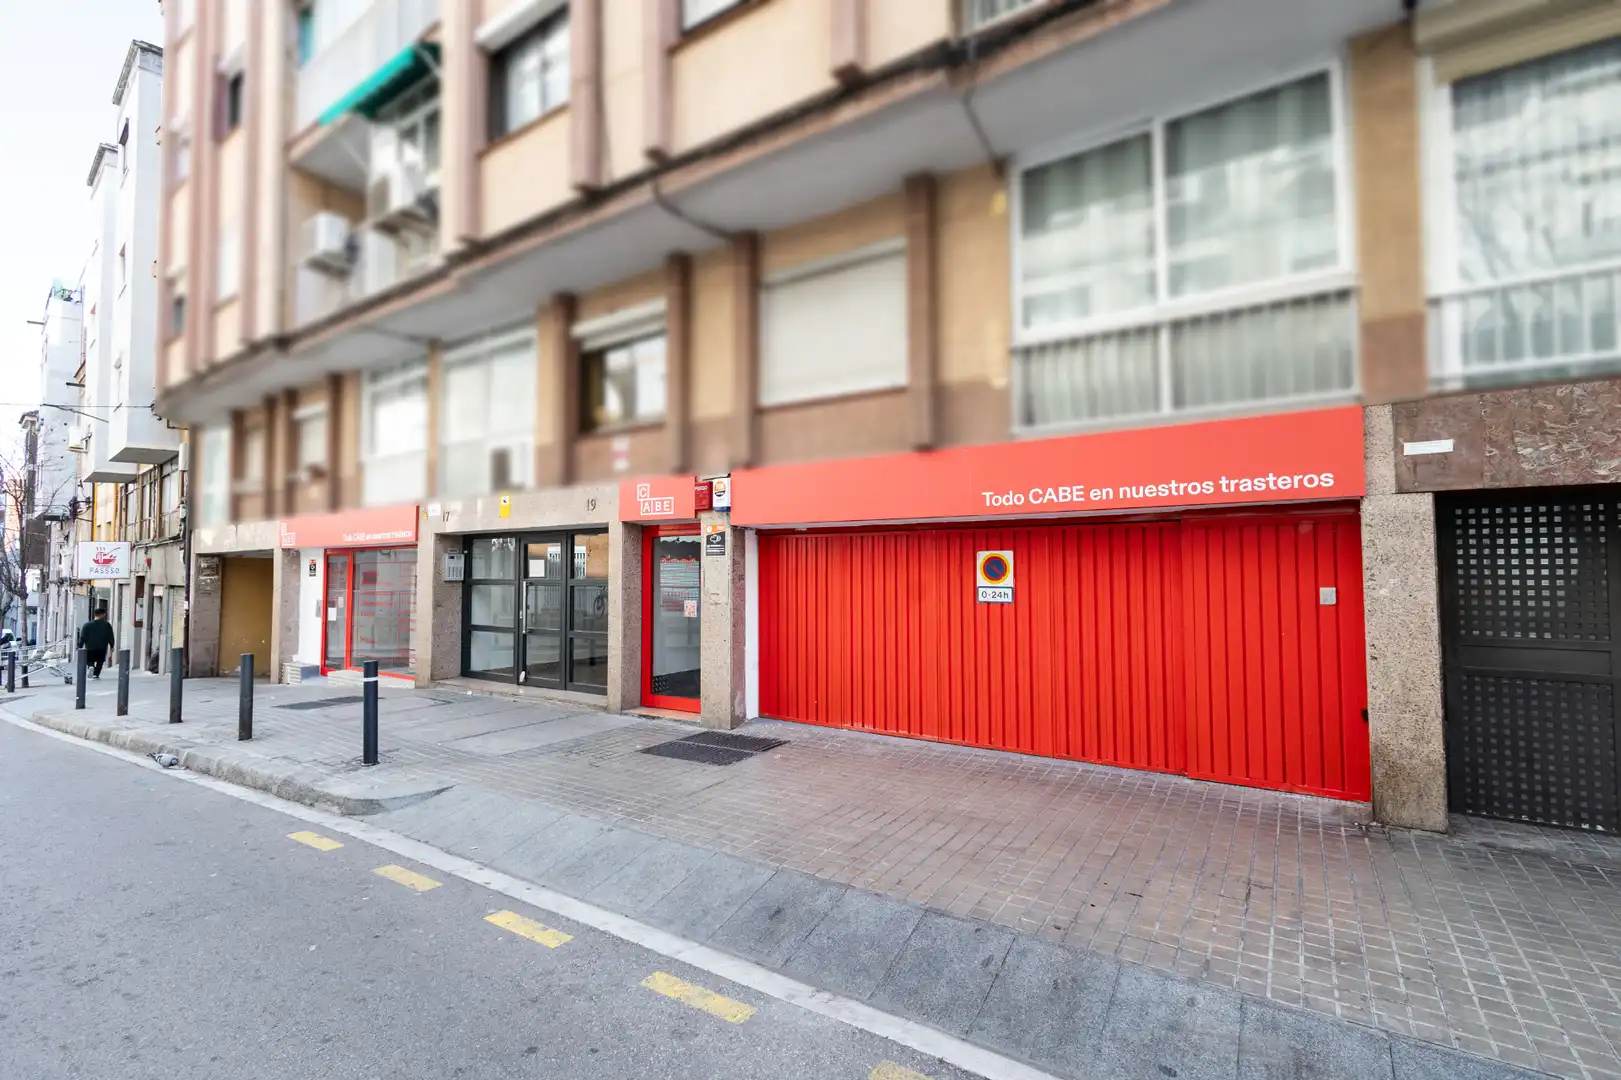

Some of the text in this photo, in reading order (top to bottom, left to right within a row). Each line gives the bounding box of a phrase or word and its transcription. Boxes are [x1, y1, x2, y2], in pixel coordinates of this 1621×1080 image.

[982, 473, 1335, 506] Todo CABE en nuestros trasteros
[587, 498, 597, 511] 19
[981, 590, 1009, 599] 0-24h
